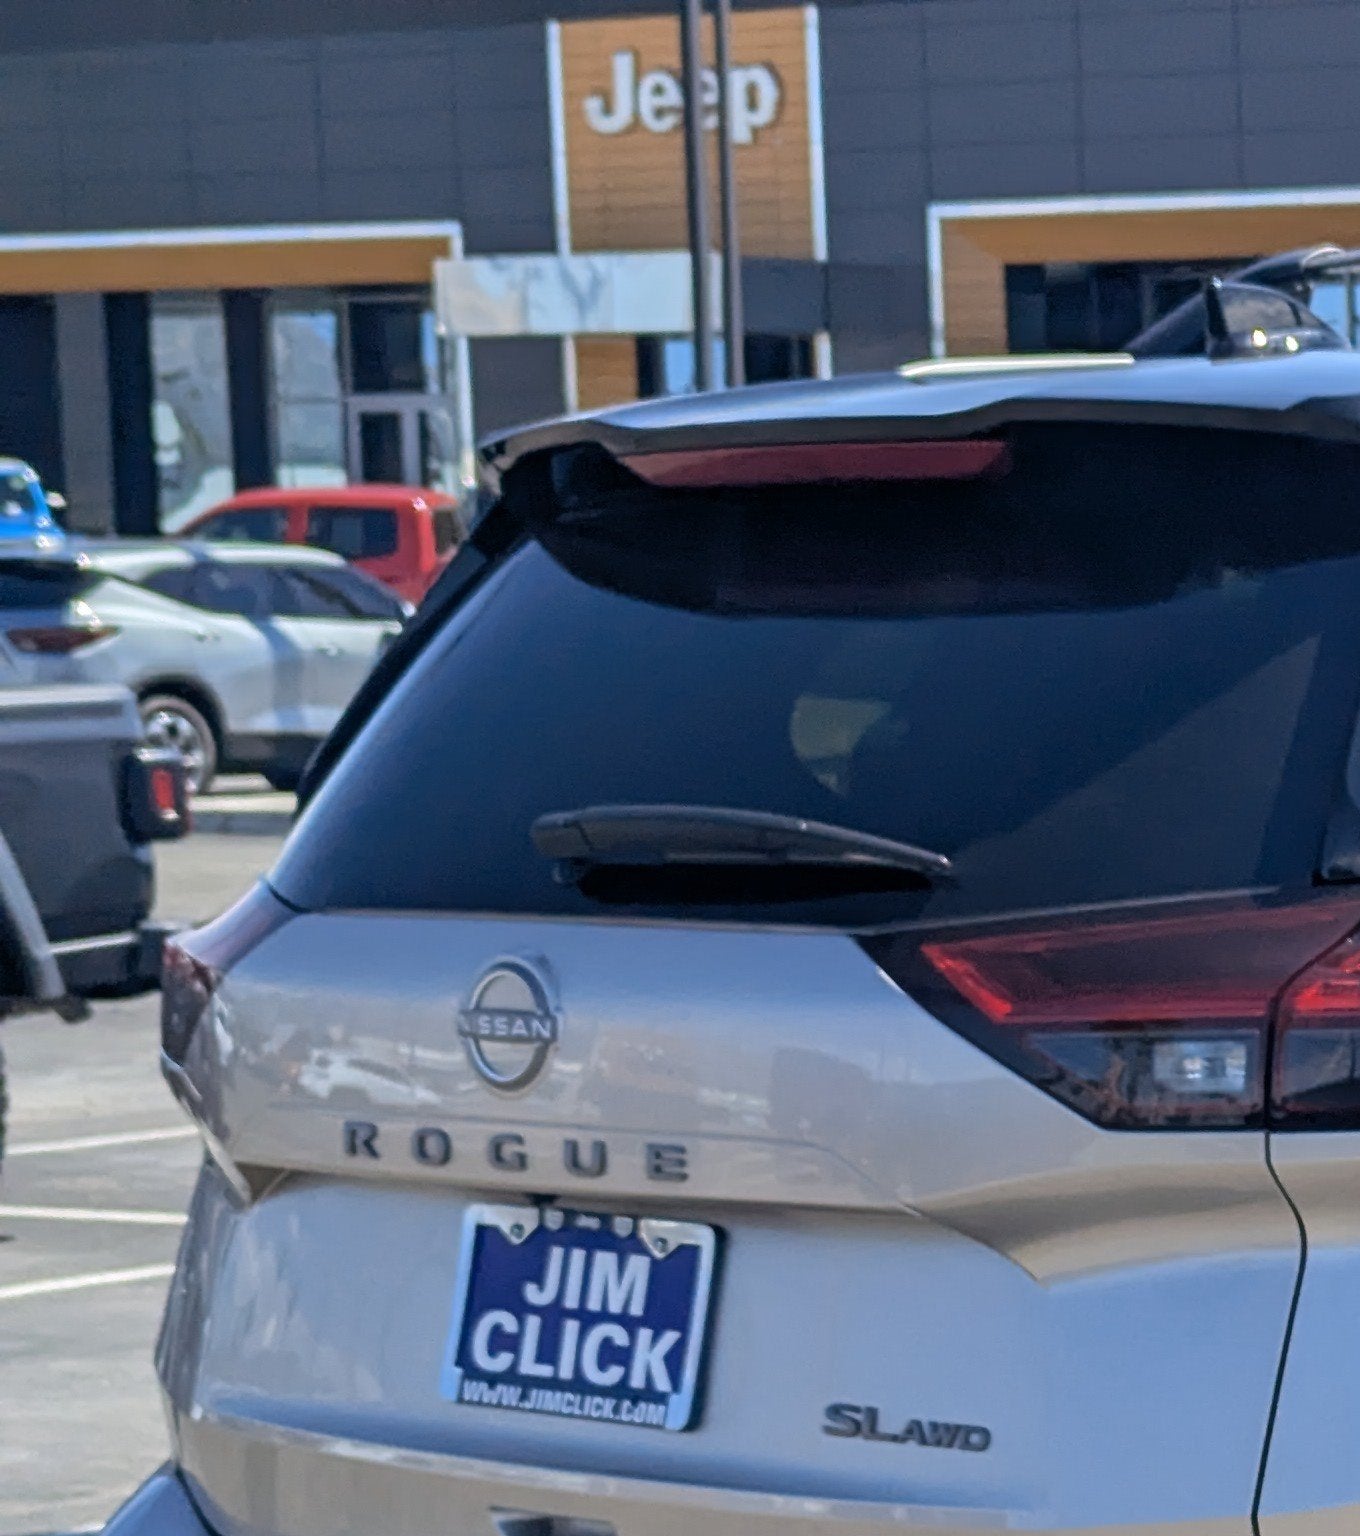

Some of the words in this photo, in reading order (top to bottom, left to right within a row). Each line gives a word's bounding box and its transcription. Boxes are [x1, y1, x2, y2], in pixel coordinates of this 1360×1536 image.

[457, 1012, 551, 1040] NSSAN
[344, 1120, 690, 1183] ROGUE
[523, 1245, 652, 1318] JIM
[472, 1310, 683, 1394] CLICK
[462, 1379, 667, 1427] WWW.JIMCLICK.COM
